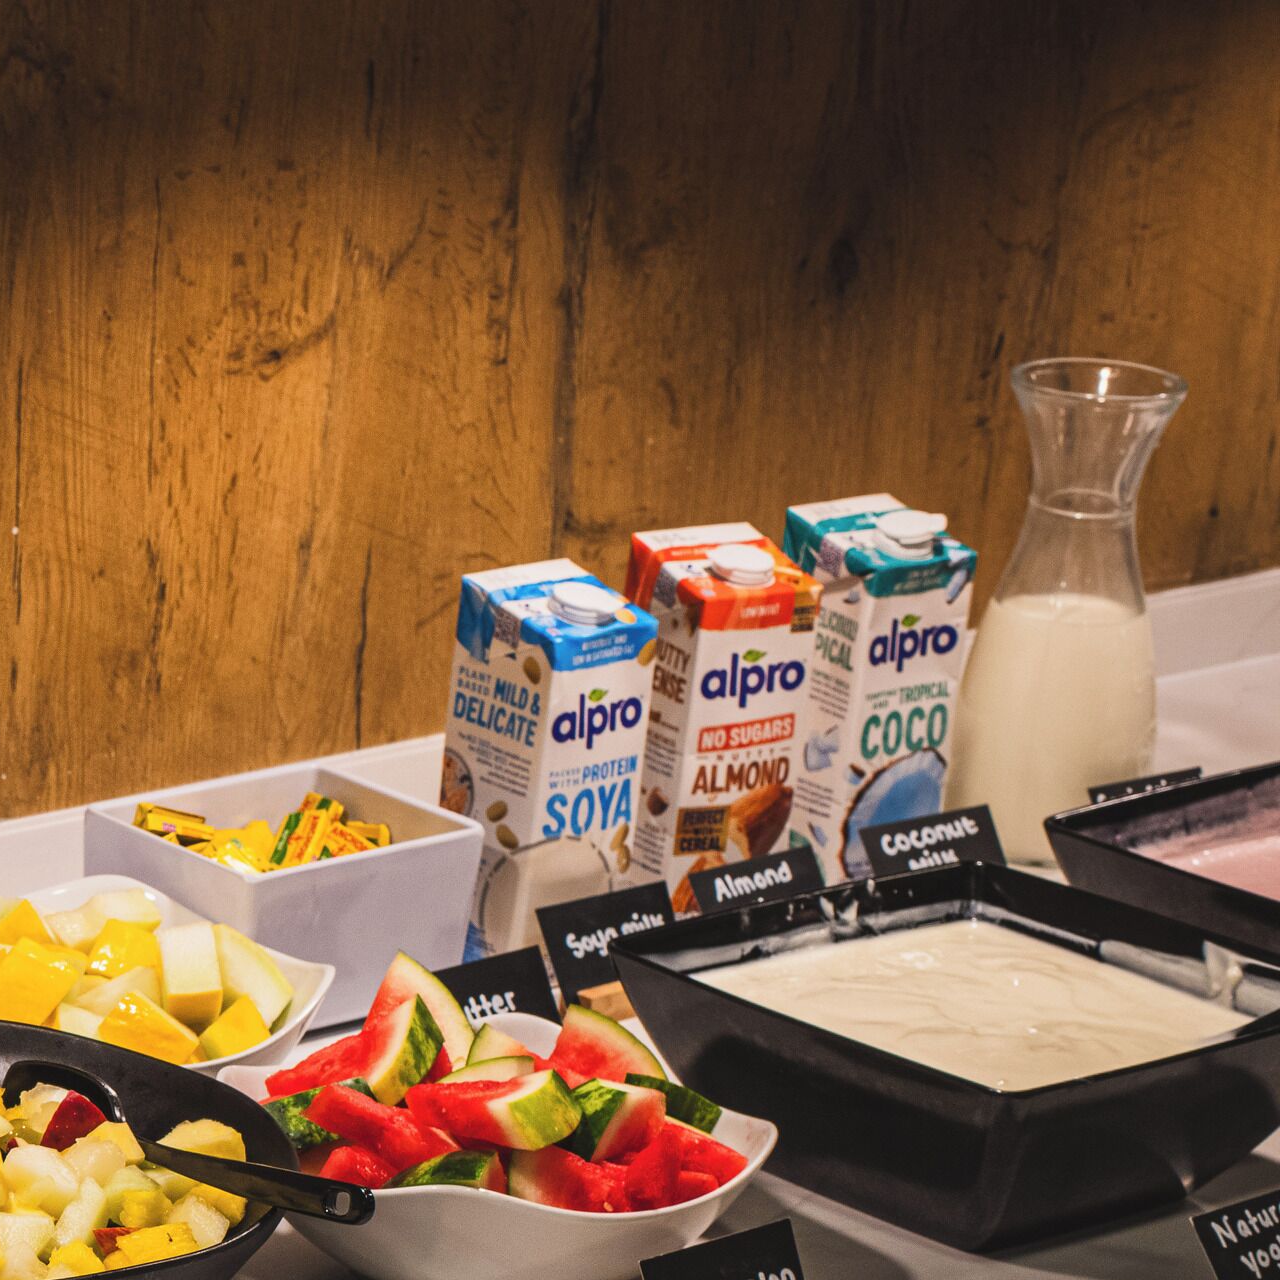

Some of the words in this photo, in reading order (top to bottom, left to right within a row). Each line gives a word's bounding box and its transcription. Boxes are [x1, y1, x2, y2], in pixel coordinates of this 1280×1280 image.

[657, 640, 691, 673] UTTY
[816, 633, 854, 671] PICAL
[870, 618, 958, 672] alpro
[494, 678, 529, 710] MILD
[530, 692, 540, 716] &
[652, 664, 687, 705] ENSE
[701, 653, 806, 708] alpro
[453, 691, 537, 747] DELICATE
[552, 693, 642, 749] alpro
[701, 729, 727, 749] NO
[729, 717, 792, 747] SUGARS
[860, 703, 948, 760] COCO
[582, 755, 638, 784] PROTEIN
[691, 756, 790, 795] ALMOND
[542, 778, 632, 838] SOYA
[881, 816, 979, 857] Coconut
[714, 860, 793, 902] Almond
[566, 926, 618, 959] Soya
[621, 912, 665, 937] milk
[463, 991, 517, 1022] tter
[1211, 1203, 1280, 1249] Natur
